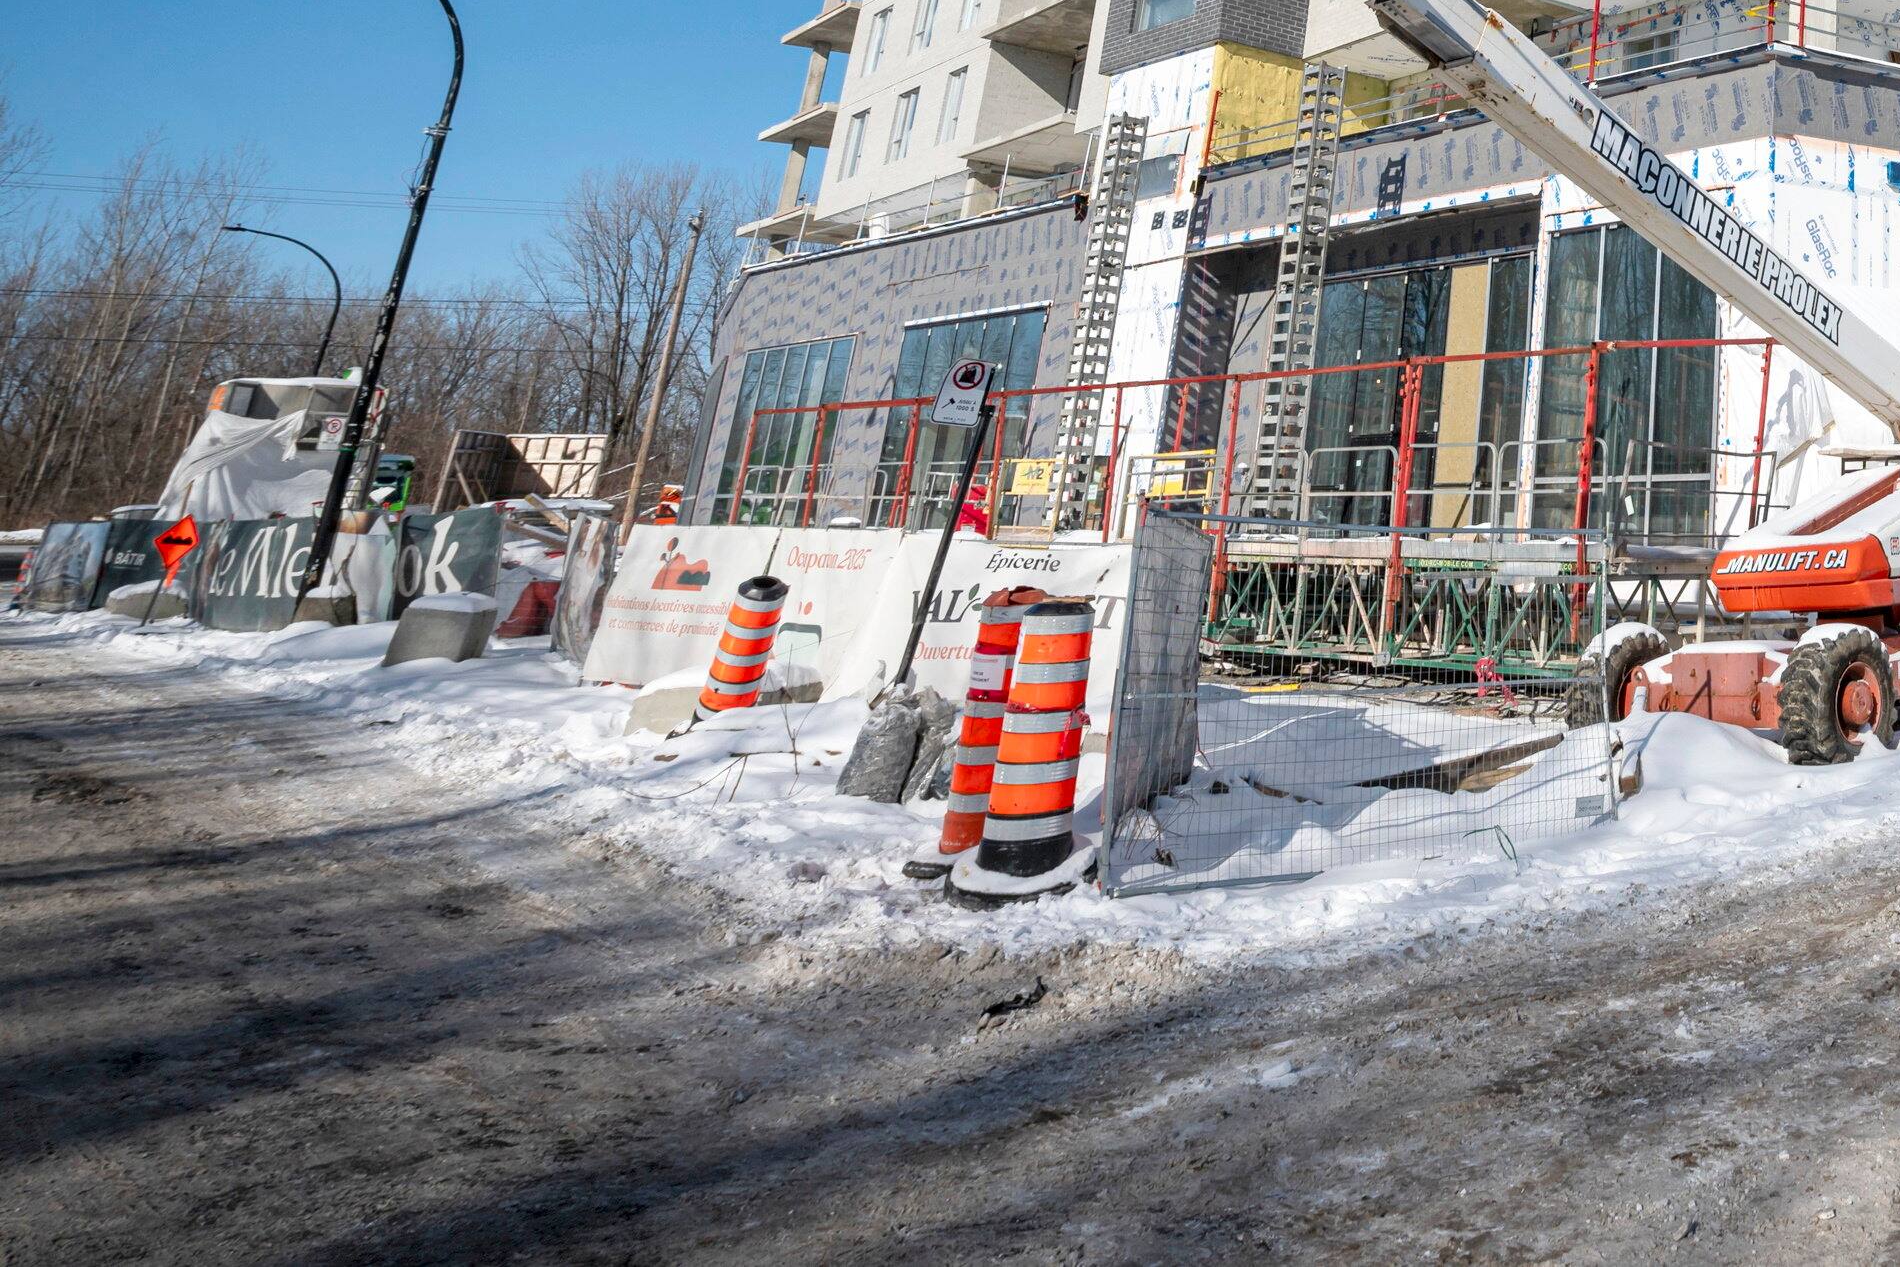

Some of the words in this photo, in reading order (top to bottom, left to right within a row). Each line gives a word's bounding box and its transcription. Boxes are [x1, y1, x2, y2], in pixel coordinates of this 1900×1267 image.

[1591, 110, 1764, 280] MAÇONNERIE
[1760, 243, 1842, 345] PROLEX
[1804, 218, 1838, 280] GlasRoc
[985, 550, 1061, 573] Épicerie
[666, 617, 679, 632] de
[912, 641, 975, 661] Ouvertu
